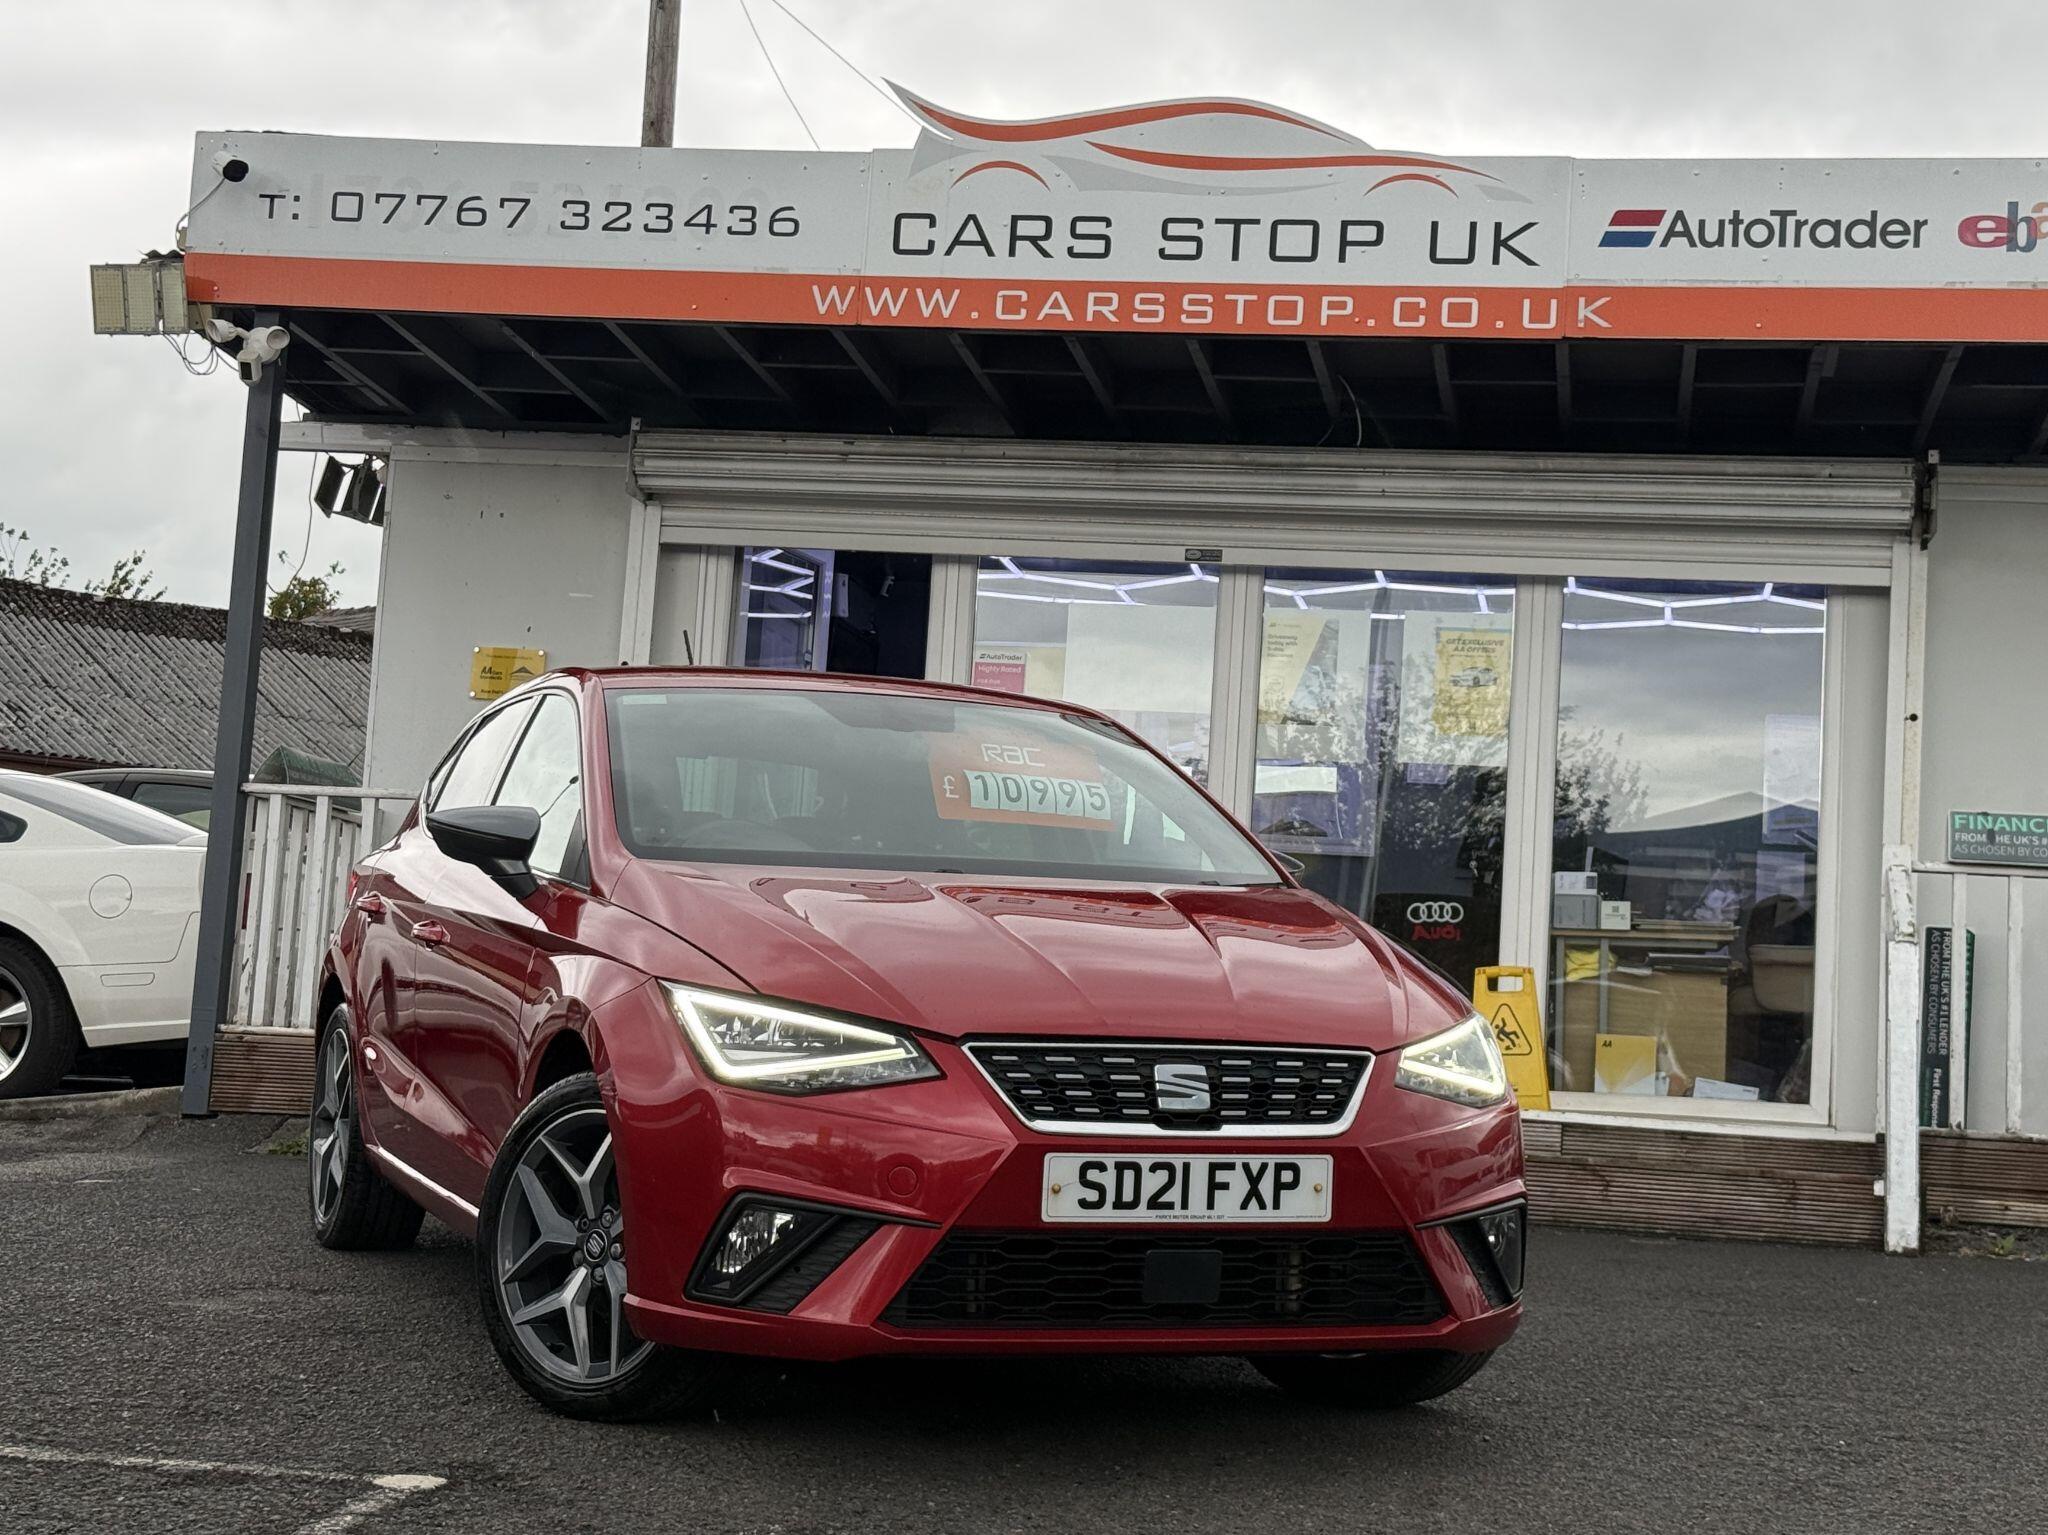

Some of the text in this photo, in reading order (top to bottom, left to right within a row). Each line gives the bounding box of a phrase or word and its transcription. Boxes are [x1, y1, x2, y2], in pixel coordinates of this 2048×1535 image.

[258, 191, 802, 238] T: 07767 323436
[1659, 209, 1929, 249] AutoTrader
[891, 211, 1541, 268] CARS STOP UK
[986, 653, 1023, 661] AutoTrader
[973, 774, 1106, 811] 10995
[1953, 843, 1968, 854] AS
[1970, 844, 2015, 856] CHOSEN
[2017, 846, 2031, 857] BY
[1955, 832, 1987, 842] FROM
[1992, 834, 2012, 845] HE
[2013, 835, 2039, 846] UK'S
[1942, 930, 1951, 957] FROM
[1941, 960, 1950, 979] THE
[1927, 929, 1941, 1054] AS CHOSEN BY CONSUMERS
[1601, 1040, 1613, 1048] AA
[1938, 1016, 1948, 1055] LENDER
[1077, 1160, 1302, 1210] SD21 FXP
